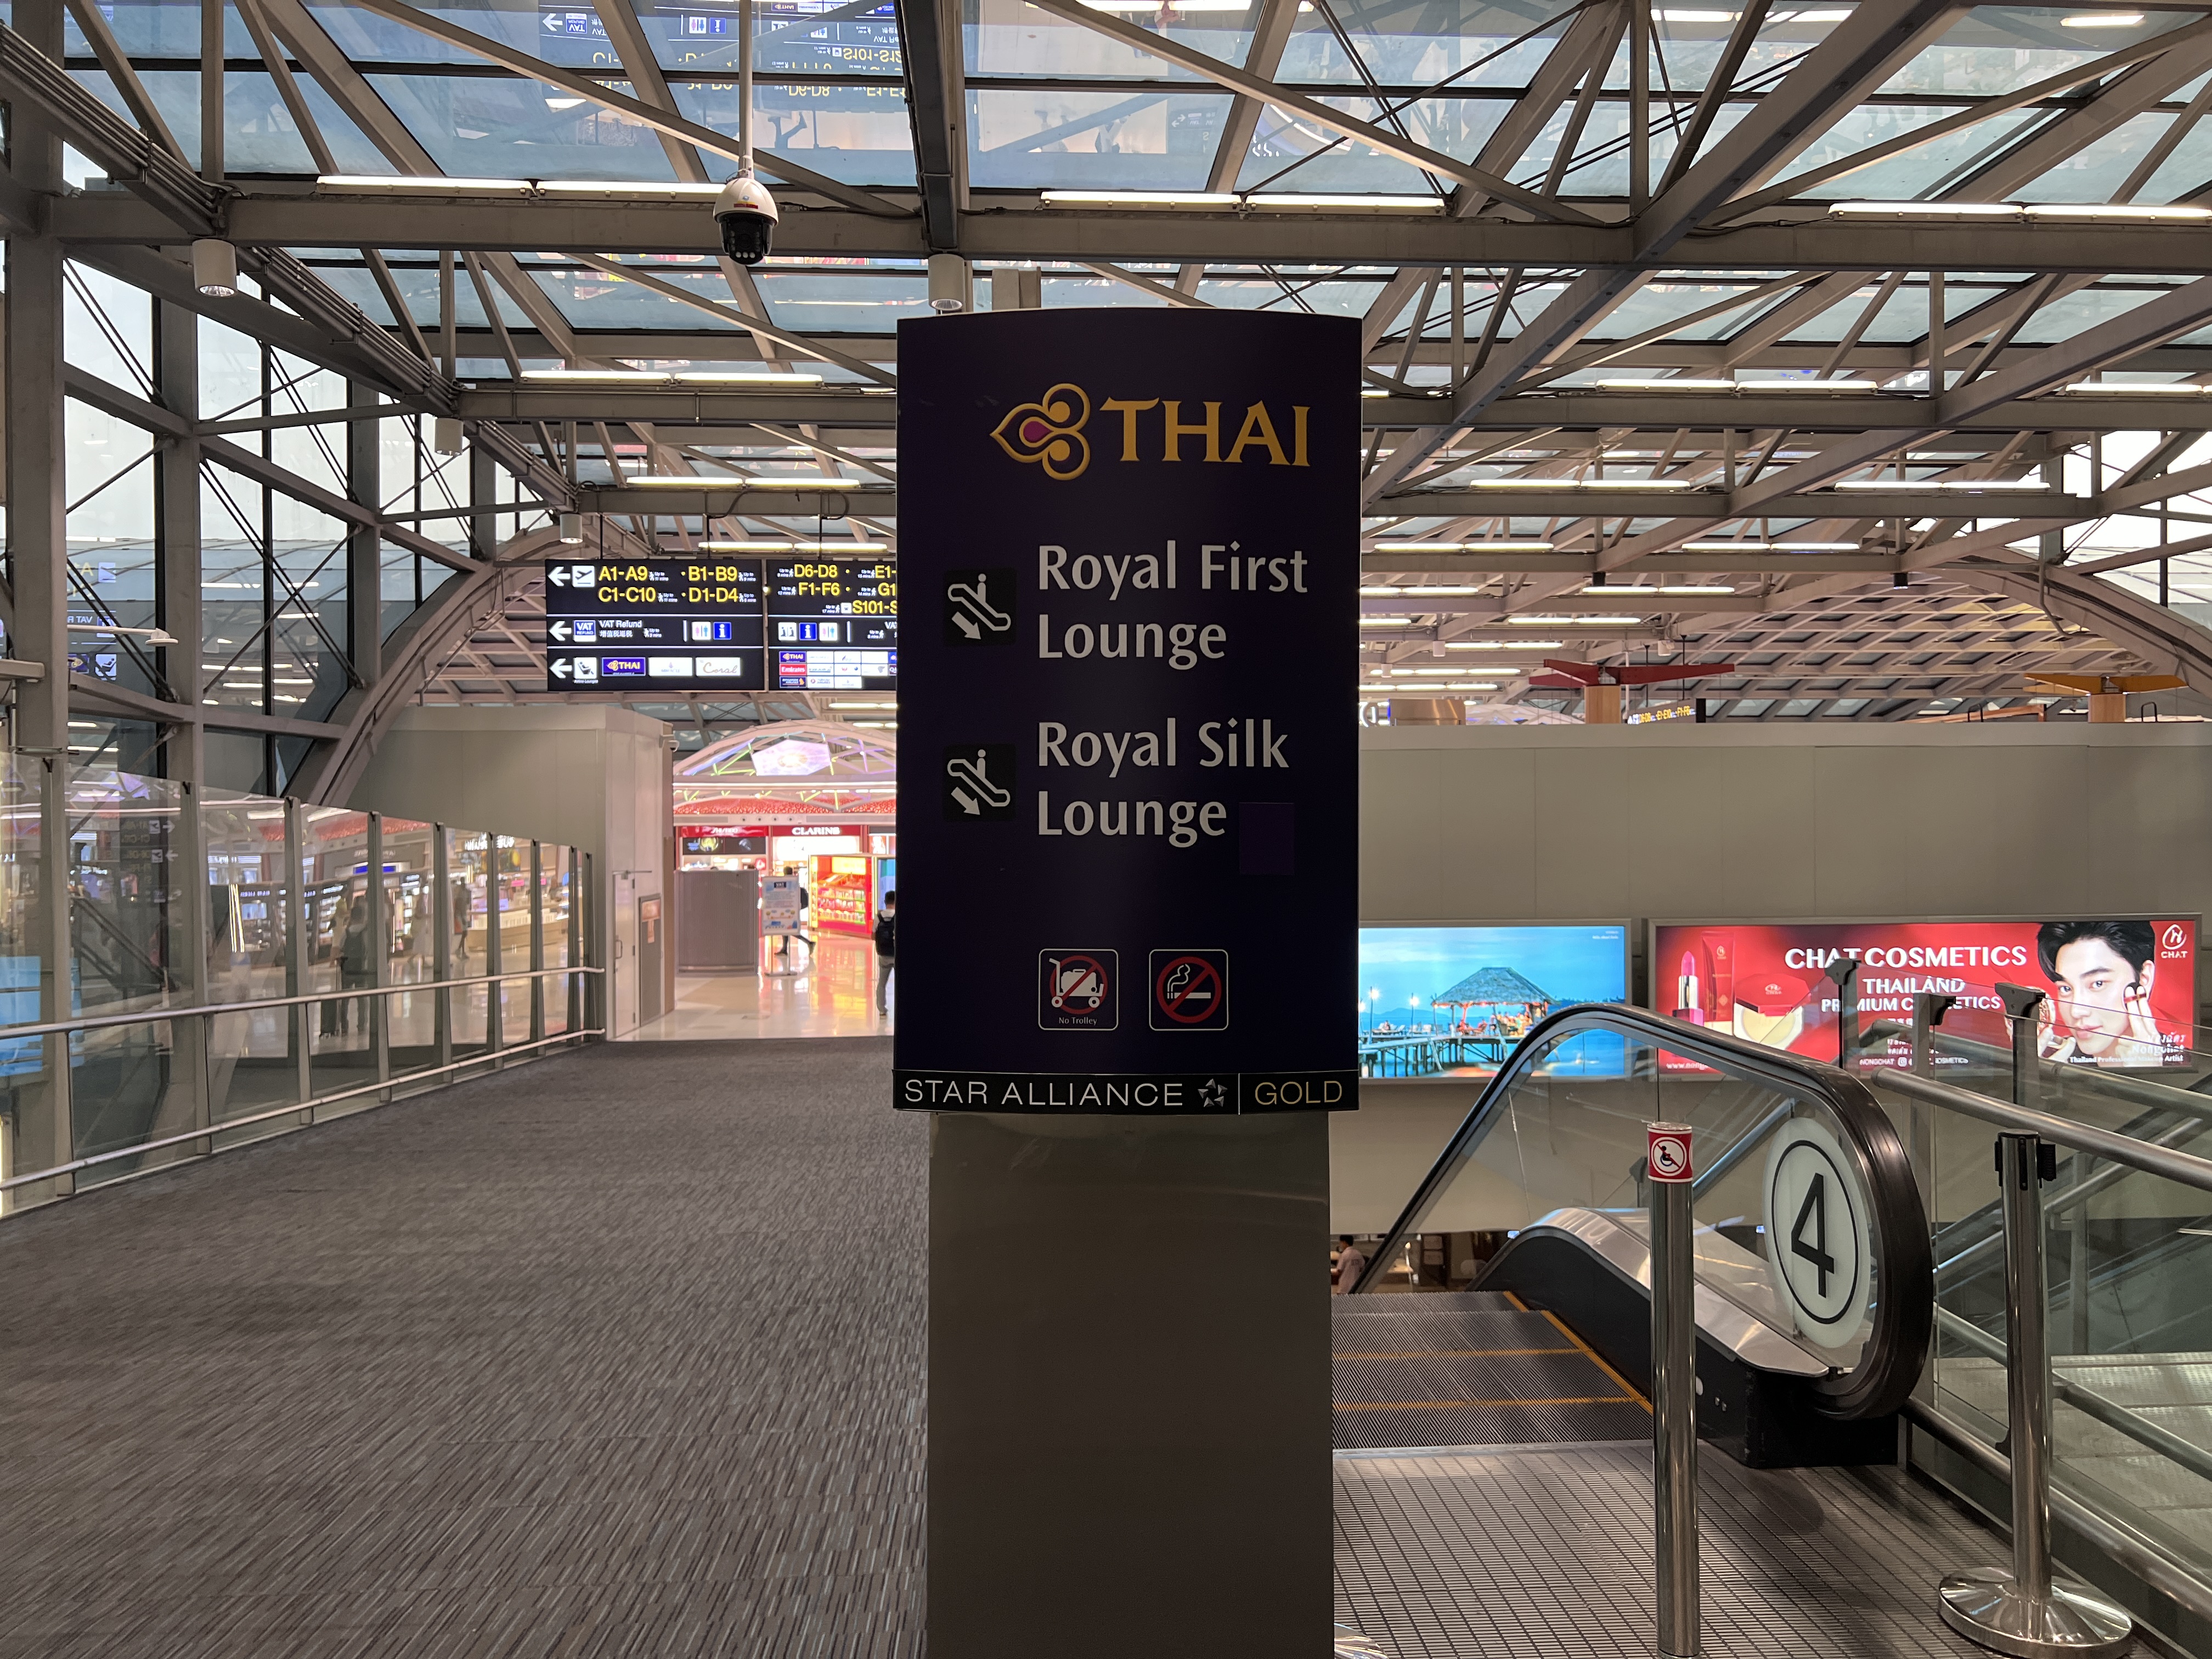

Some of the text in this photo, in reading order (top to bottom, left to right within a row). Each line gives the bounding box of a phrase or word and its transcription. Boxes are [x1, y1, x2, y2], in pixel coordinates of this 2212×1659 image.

[1099, 397, 1311, 466] THAI
[599, 566, 648, 581] A1-A9
[689, 566, 737, 582] B1-B9
[794, 564, 838, 578] D6-D8
[1040, 540, 1308, 600] Royal First
[599, 587, 656, 602] C1-C10
[689, 587, 738, 602] D1-D4
[799, 582, 840, 595] F1-F6
[1040, 614, 1227, 670] Lounge
[703, 662, 737, 674] Coral
[1039, 718, 1289, 777] Royal Silk
[1039, 791, 1227, 848] Lounge
[792, 827, 841, 835] CLARINS
[1785, 946, 2027, 969] CHAT COSMETICS
[1863, 976, 1966, 994] THAILAND
[1821, 996, 2000, 1012] PRMIUM CETICS
[1071, 1017, 1097, 1025] Trolley
[905, 1079, 1342, 1107] STAR ALLIANCE GOLD
[1791, 1172, 1835, 1298] 4
